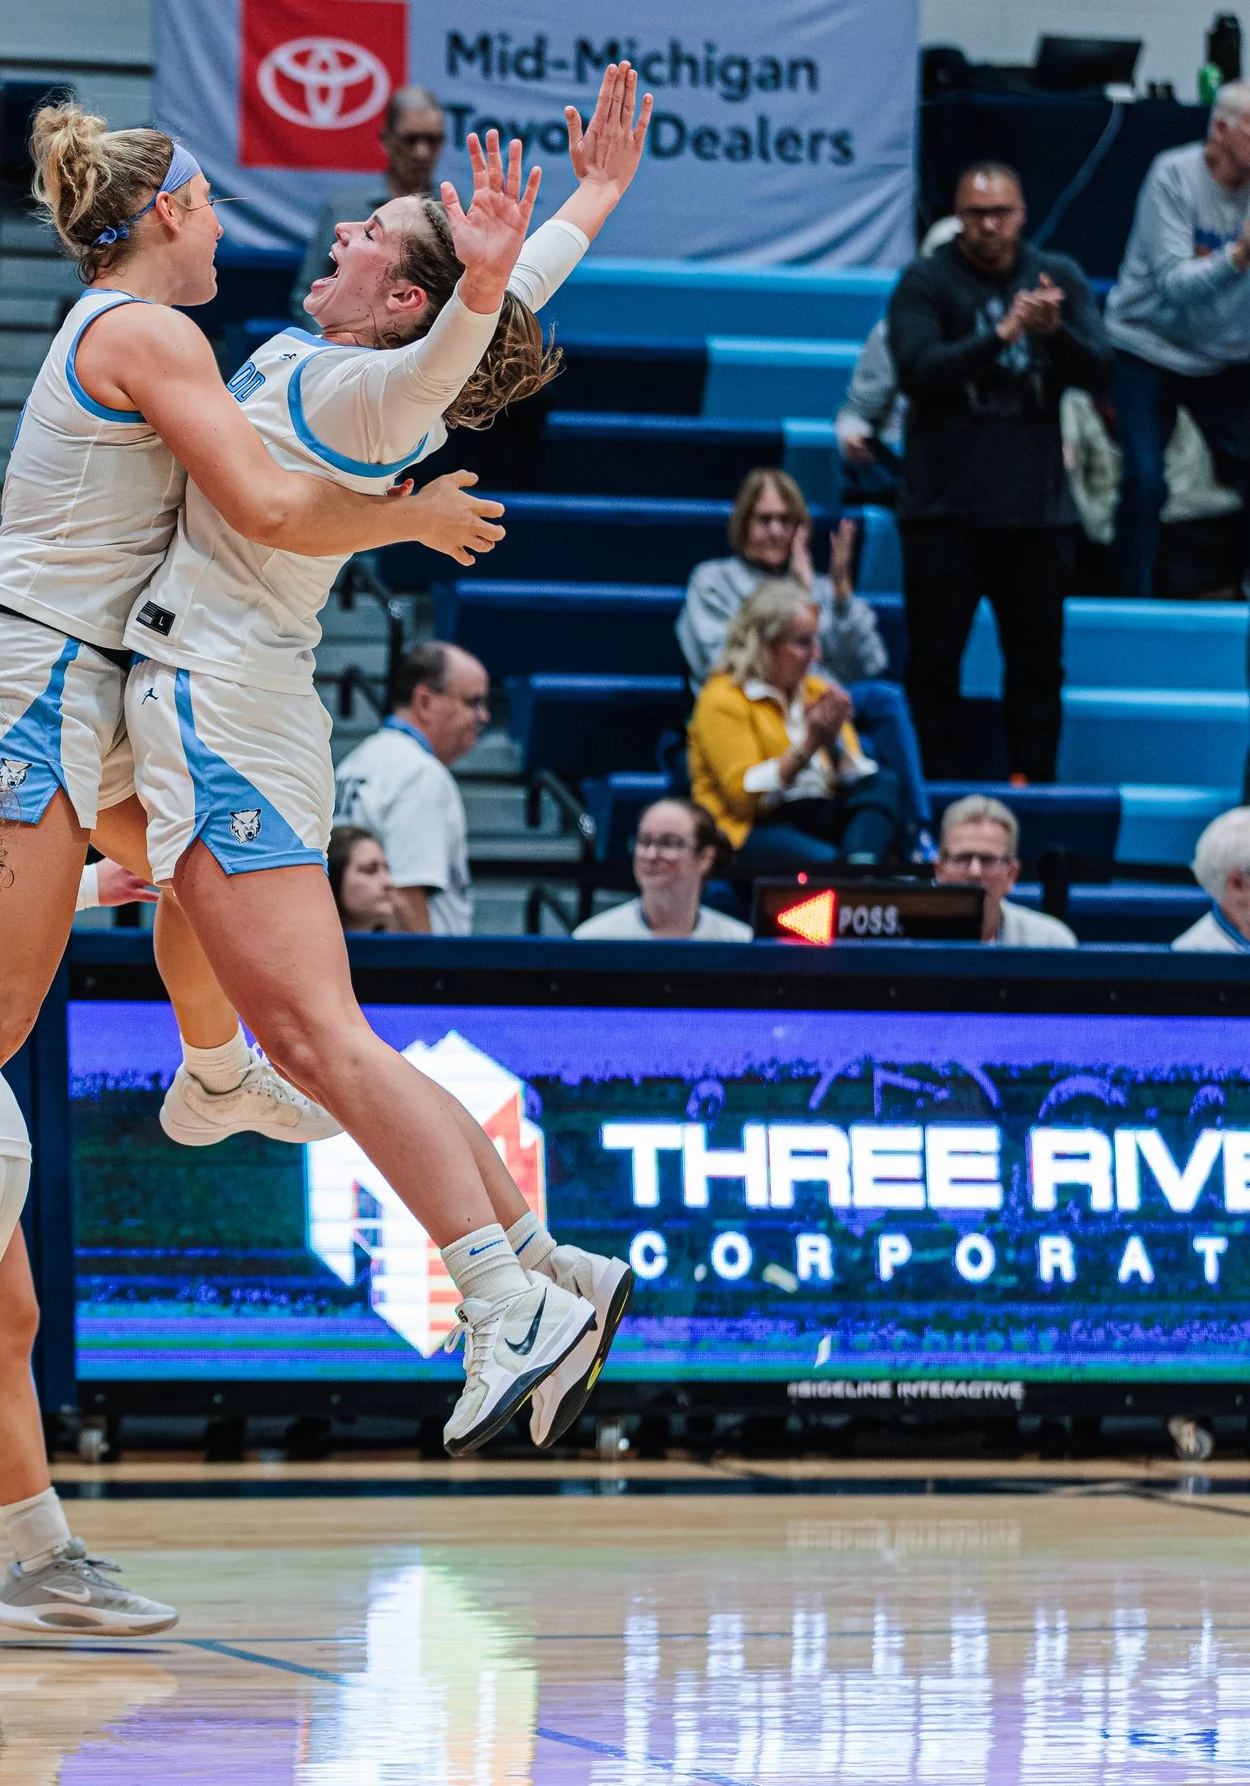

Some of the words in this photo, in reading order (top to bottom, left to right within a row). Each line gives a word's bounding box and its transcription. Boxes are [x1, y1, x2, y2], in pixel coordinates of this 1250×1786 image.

[441, 102, 591, 162] Toyo
[651, 111, 855, 166] Dealers
[602, 1122, 1004, 1210] THREE
[630, 1230, 1229, 1284] CORPORAT
